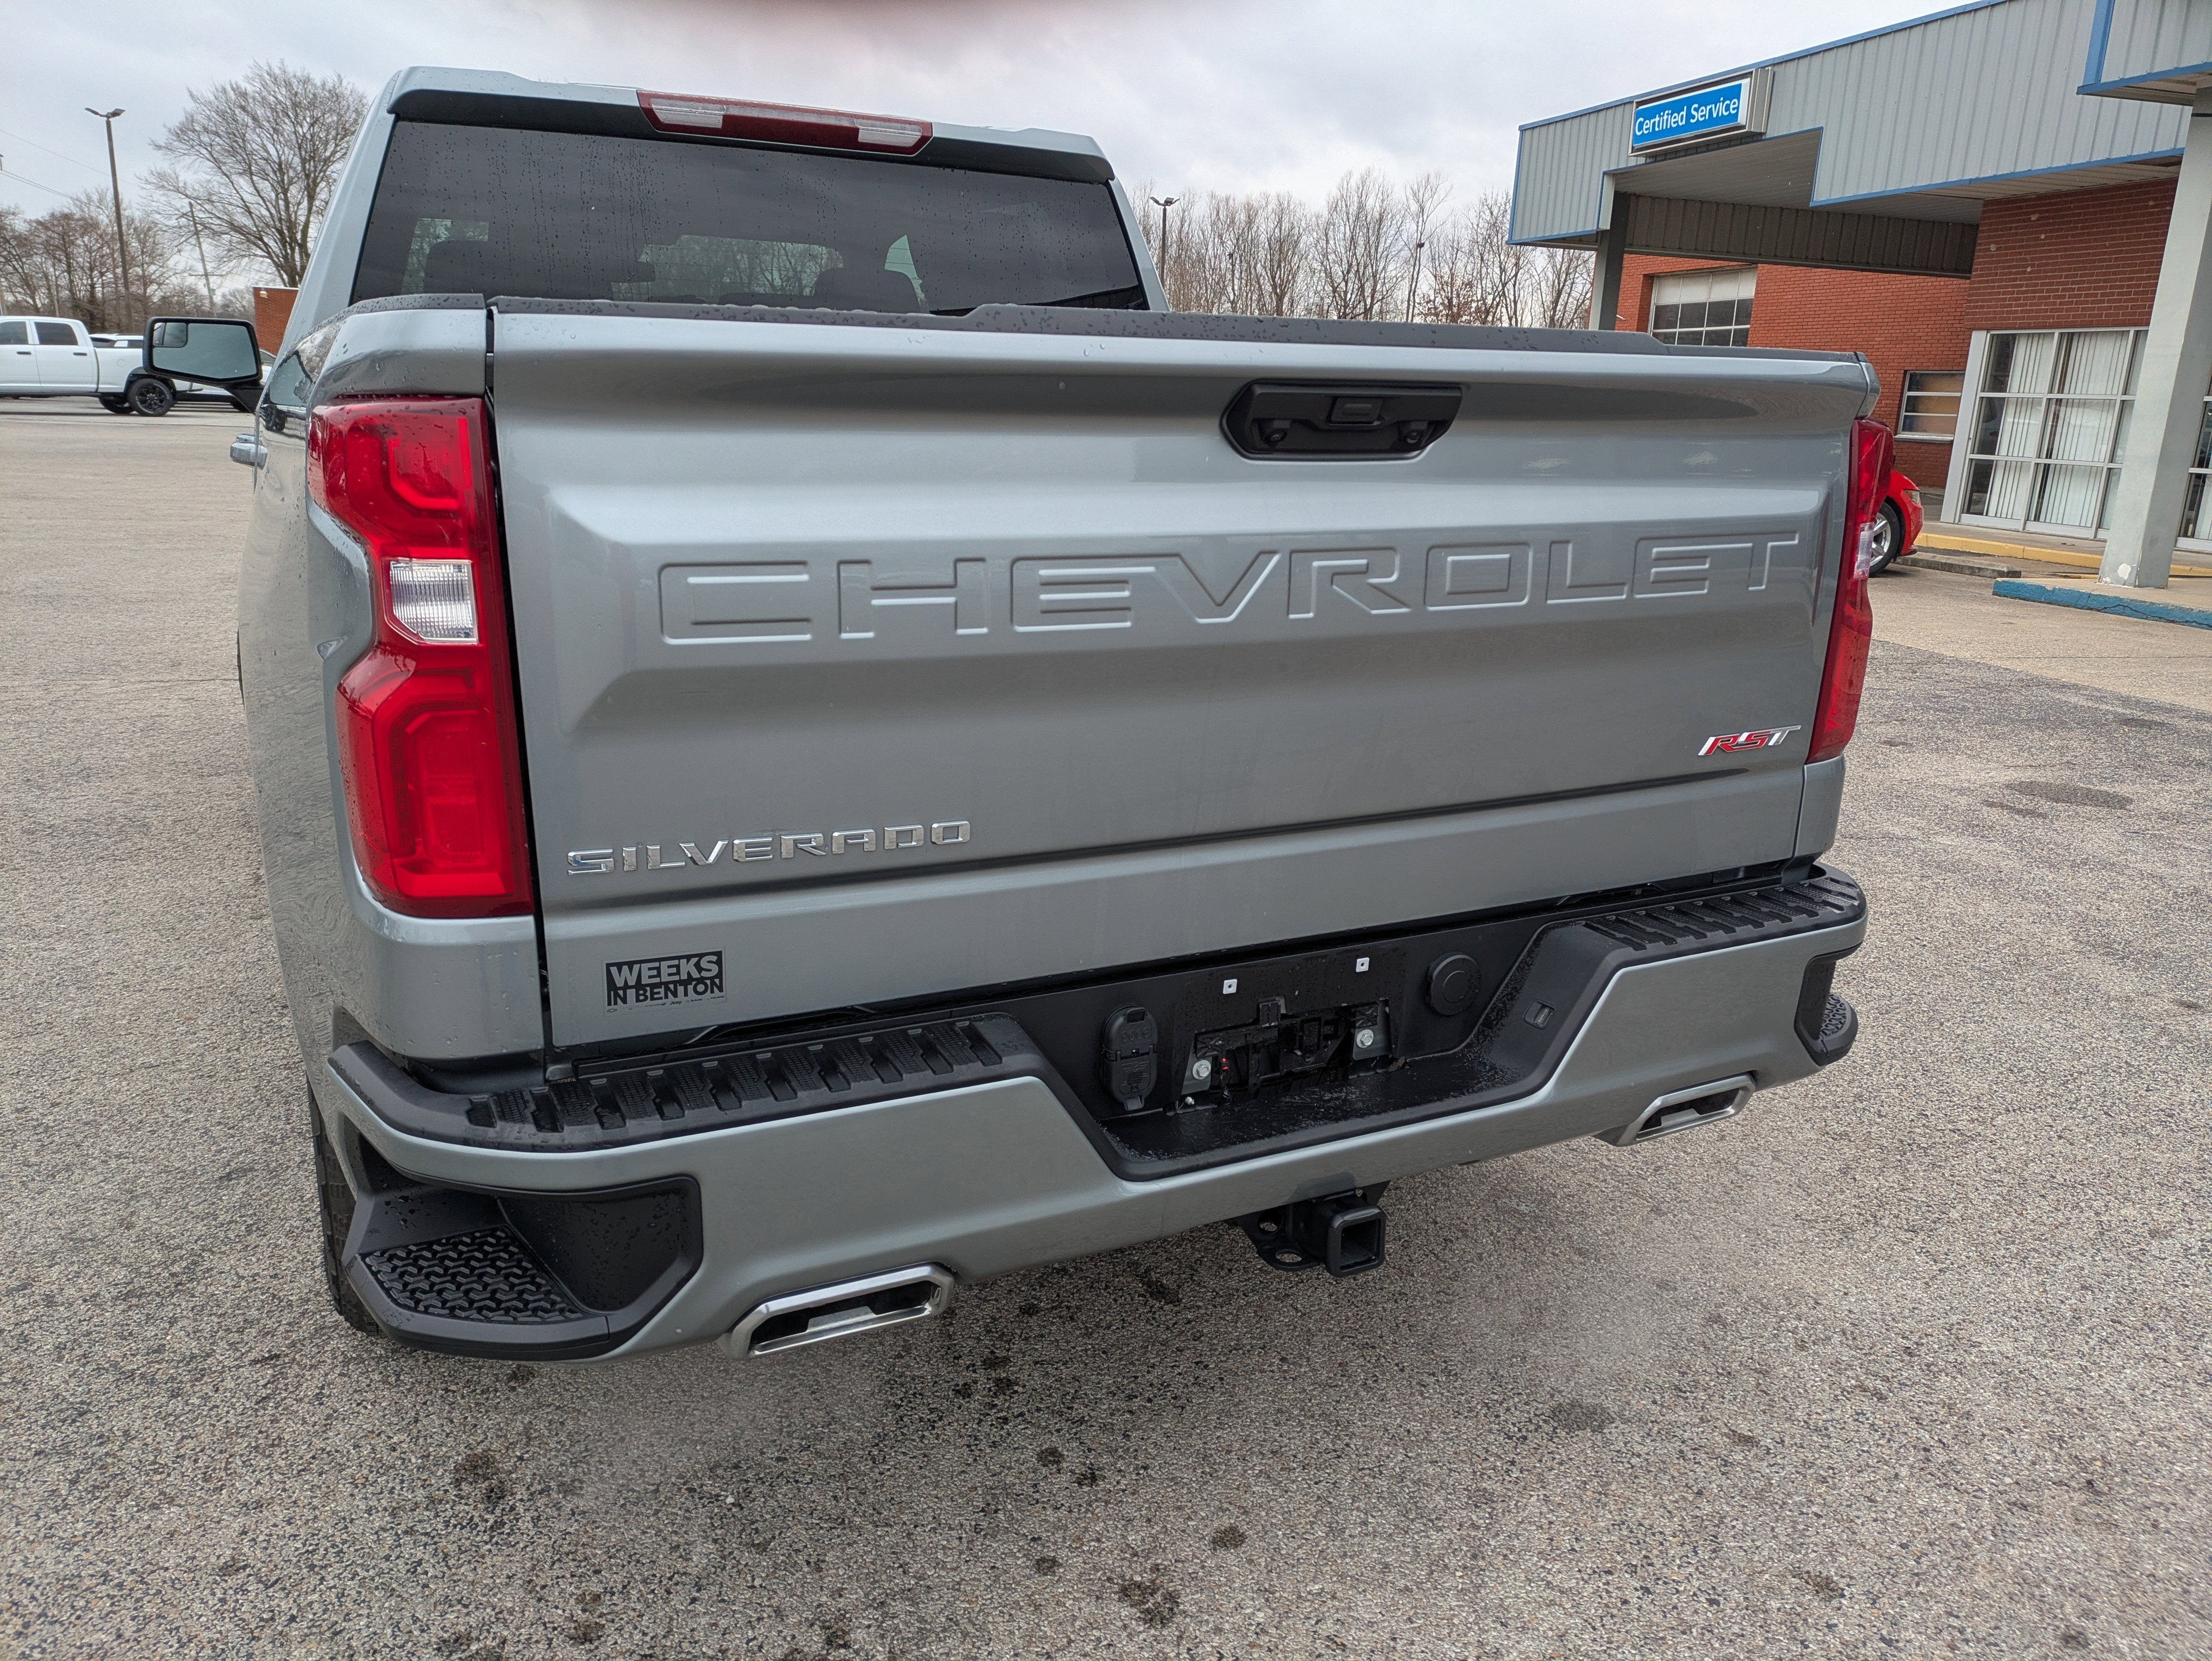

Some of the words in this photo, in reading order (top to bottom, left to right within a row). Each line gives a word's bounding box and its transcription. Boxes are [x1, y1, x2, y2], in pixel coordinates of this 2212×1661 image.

[1635, 106, 1687, 136] Certified
[1690, 97, 1738, 123] Service
[658, 530, 1800, 645] CHEVROLET
[1698, 724, 1802, 756] RST
[567, 819, 971, 876] SILVERADO
[609, 955, 719, 987] WEEKS
[635, 979, 724, 1003] BENTON
